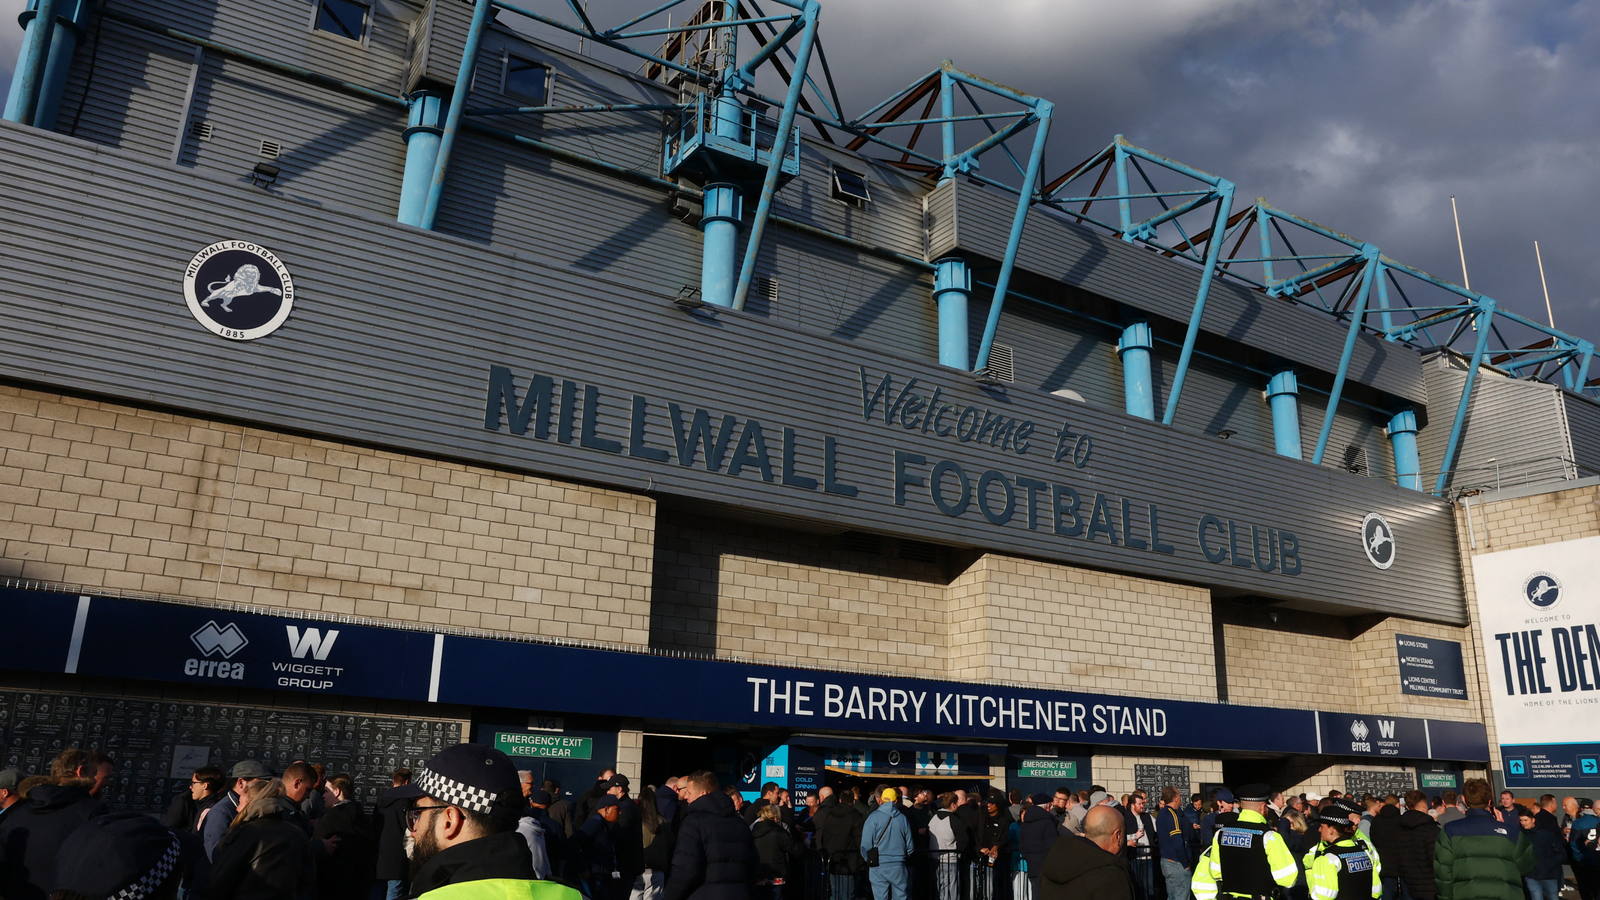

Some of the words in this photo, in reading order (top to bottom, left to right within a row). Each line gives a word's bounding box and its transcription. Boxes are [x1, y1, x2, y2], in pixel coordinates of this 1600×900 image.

[186, 242, 229, 279] MILLWALL
[231, 241, 283, 271] FOOTBALL
[281, 272, 292, 300] CLUB
[219, 327, 245, 339] 1885
[858, 365, 1036, 455] Welcome
[1052, 420, 1093, 469] to
[484, 363, 859, 498] MILLWALL
[893, 449, 1175, 555] FOOTBALL
[1197, 513, 1302, 577] CLUB
[1524, 615, 1559, 625] WELCOME
[1403, 640, 1416, 648] LIONS
[1405, 656, 1420, 664] NORTH
[1420, 657, 1434, 665] STAND
[1494, 629, 1552, 696] THE
[272, 661, 344, 677] WIGGETT
[277, 676, 334, 690] GROUP
[1409, 684, 1429, 692] MILLWALL
[1428, 686, 1452, 694] COMMUNITY
[746, 676, 815, 718] THE
[824, 683, 928, 724] BARRY
[935, 692, 1088, 733] KITCHENER
[1092, 703, 1168, 738] STAND
[1558, 698, 1573, 706] THE
[1575, 697, 1599, 705] LIONS
[536, 717, 557, 729] W3
[500, 734, 561, 746] EMERGENCY
[562, 738, 583, 747] EXIT
[511, 746, 538, 755] KEEP
[539, 747, 571, 757] CLEAR
[1022, 760, 1060, 769] EMERGENCY
[1030, 769, 1046, 777] KEEP
[1222, 836, 1250, 847] POLICE
